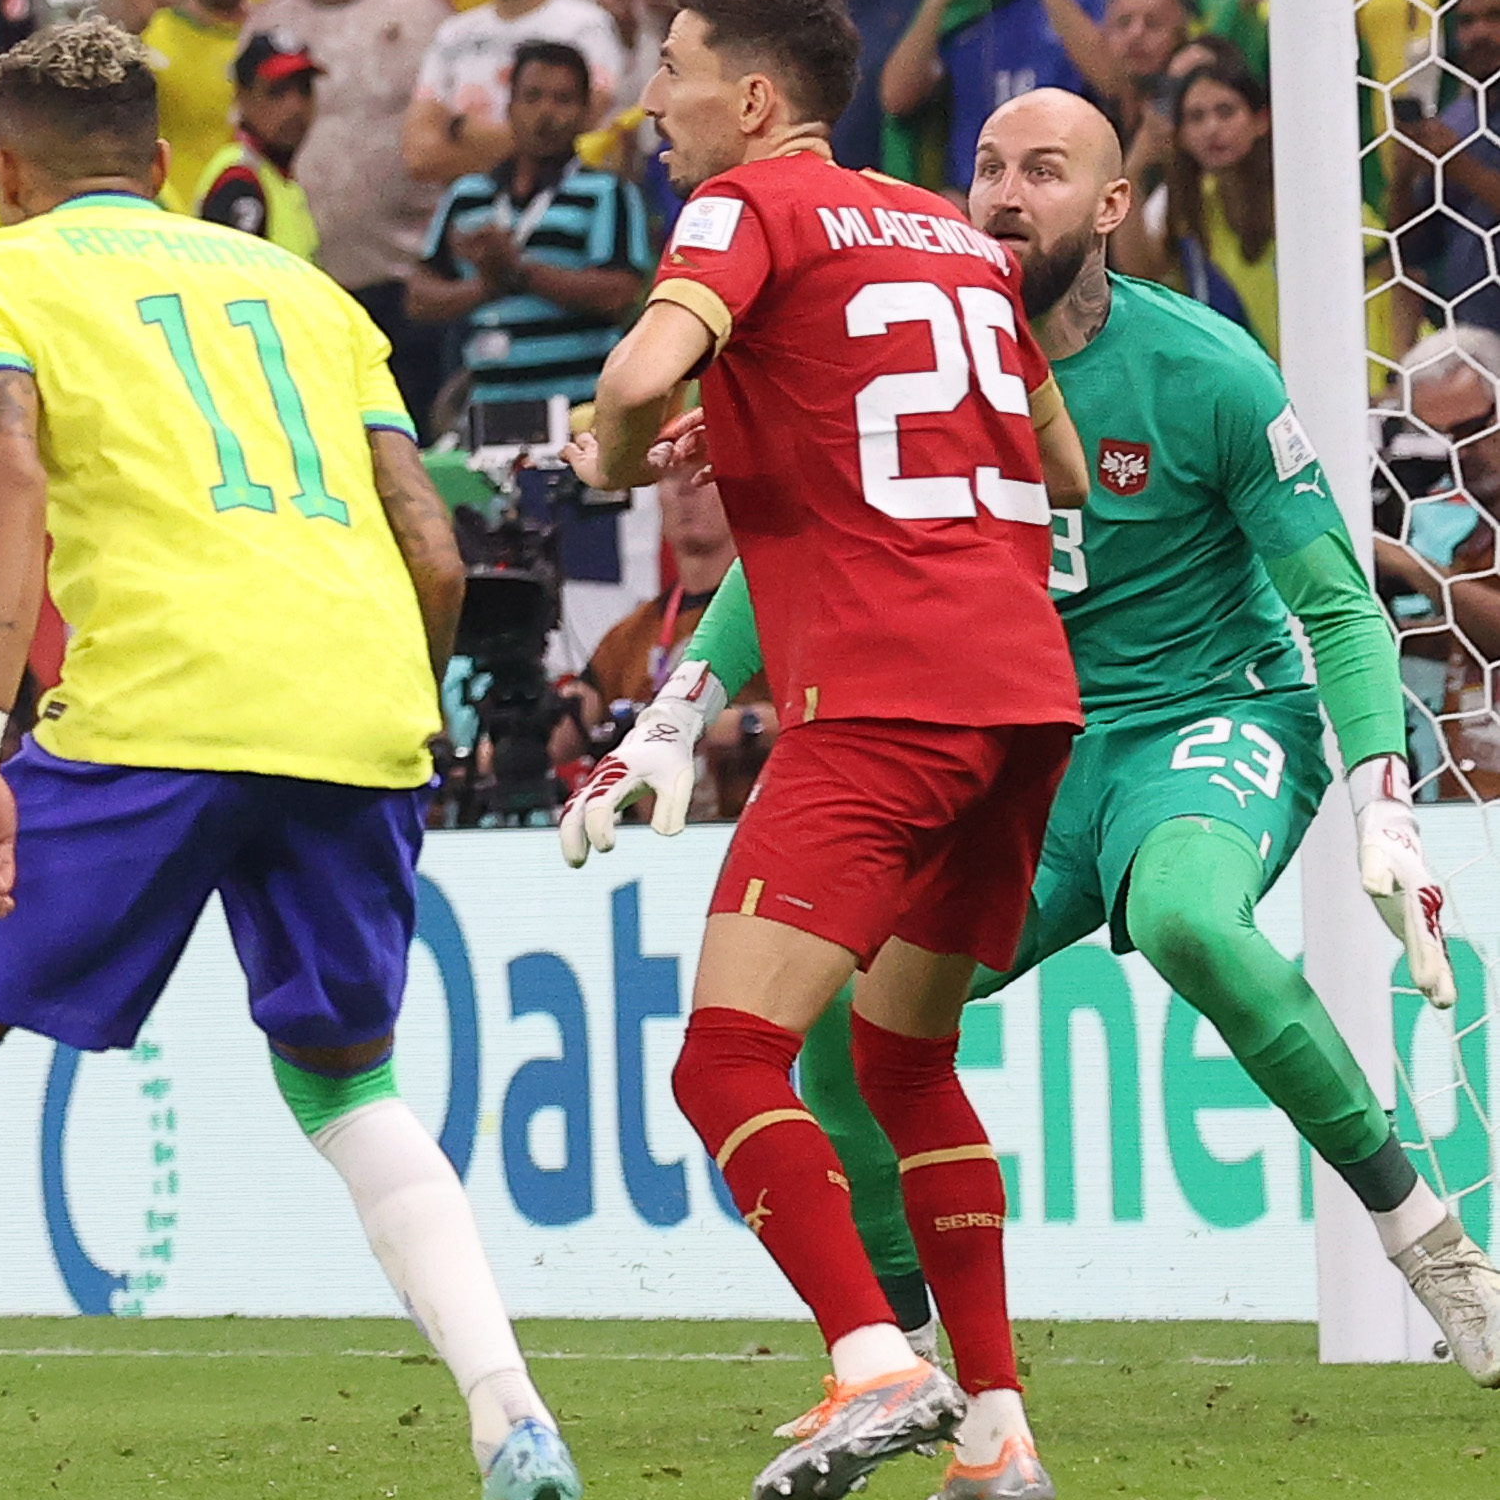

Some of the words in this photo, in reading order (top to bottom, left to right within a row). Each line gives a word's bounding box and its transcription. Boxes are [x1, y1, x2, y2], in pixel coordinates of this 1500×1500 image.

[136, 293, 351, 528] 11
[844, 281, 1053, 527] 25
[1048, 507, 1089, 593] 3
[1169, 715, 1286, 800] 23
